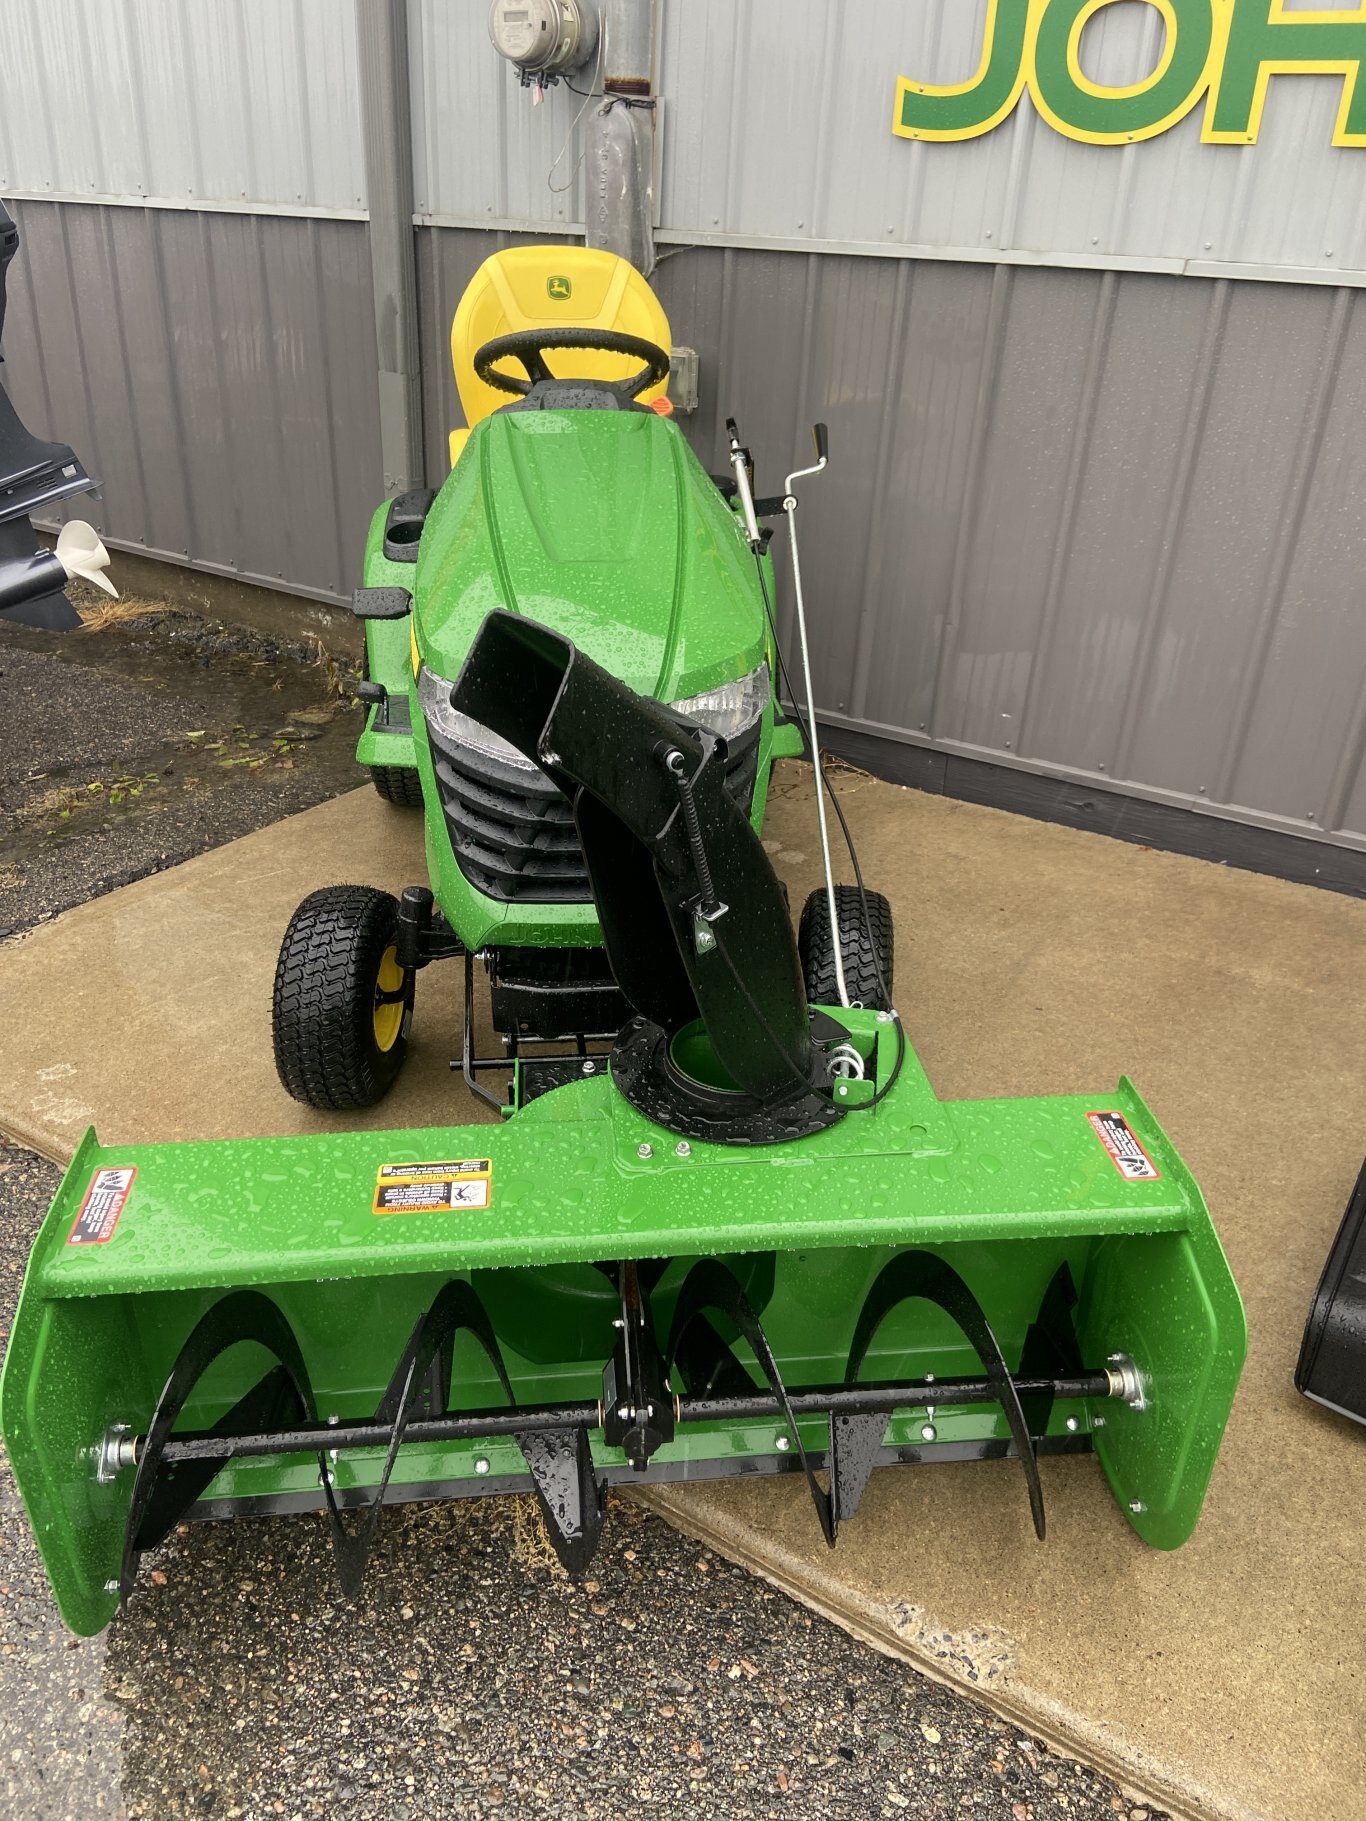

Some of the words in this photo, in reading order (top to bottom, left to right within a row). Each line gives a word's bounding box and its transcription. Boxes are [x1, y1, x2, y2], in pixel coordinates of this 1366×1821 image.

[893, 0, 1366, 146] JOH
[1089, 1115, 1114, 1148] DANGER
[98, 1201, 123, 1238] DANGER
